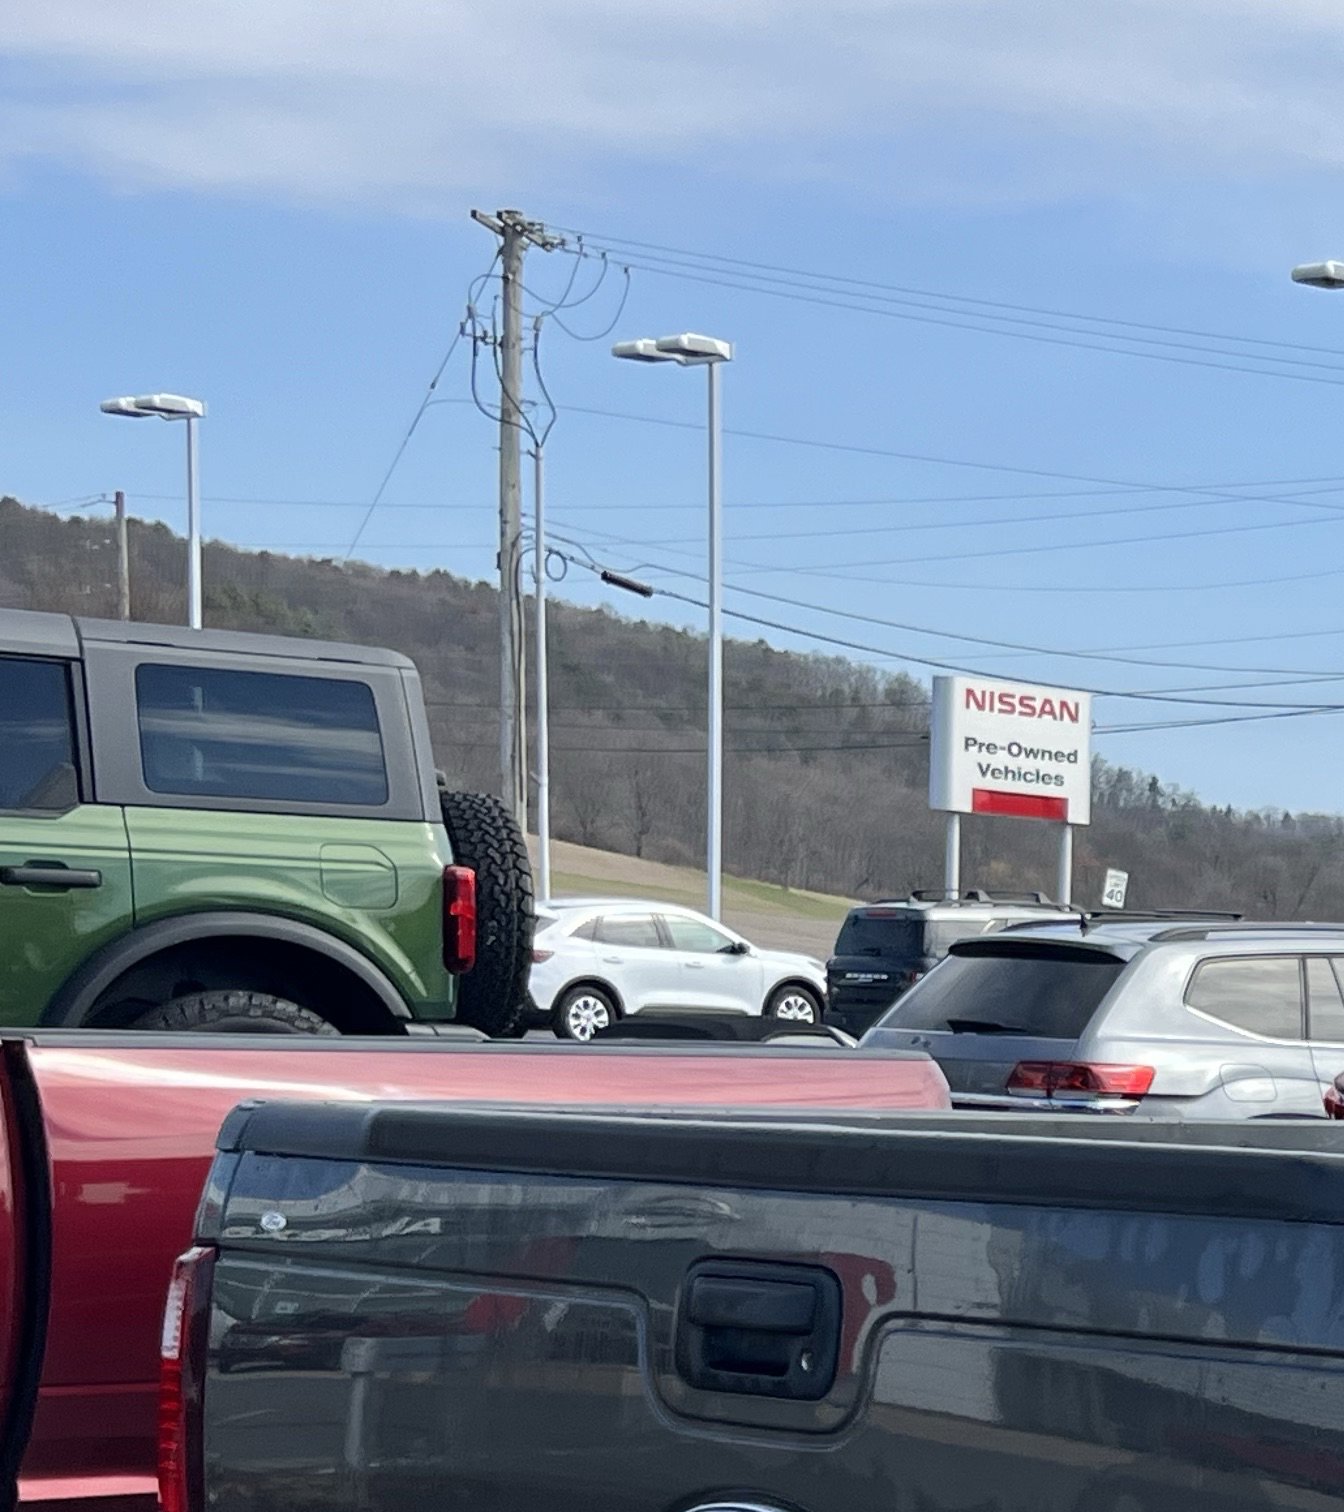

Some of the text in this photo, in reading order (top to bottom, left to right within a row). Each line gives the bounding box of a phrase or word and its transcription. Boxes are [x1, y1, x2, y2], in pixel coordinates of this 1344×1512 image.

[965, 688, 1080, 724] NISSAN
[964, 736, 1078, 764] Pre-Owned
[977, 762, 1065, 787] Vehicles
[1106, 888, 1123, 903] 40
